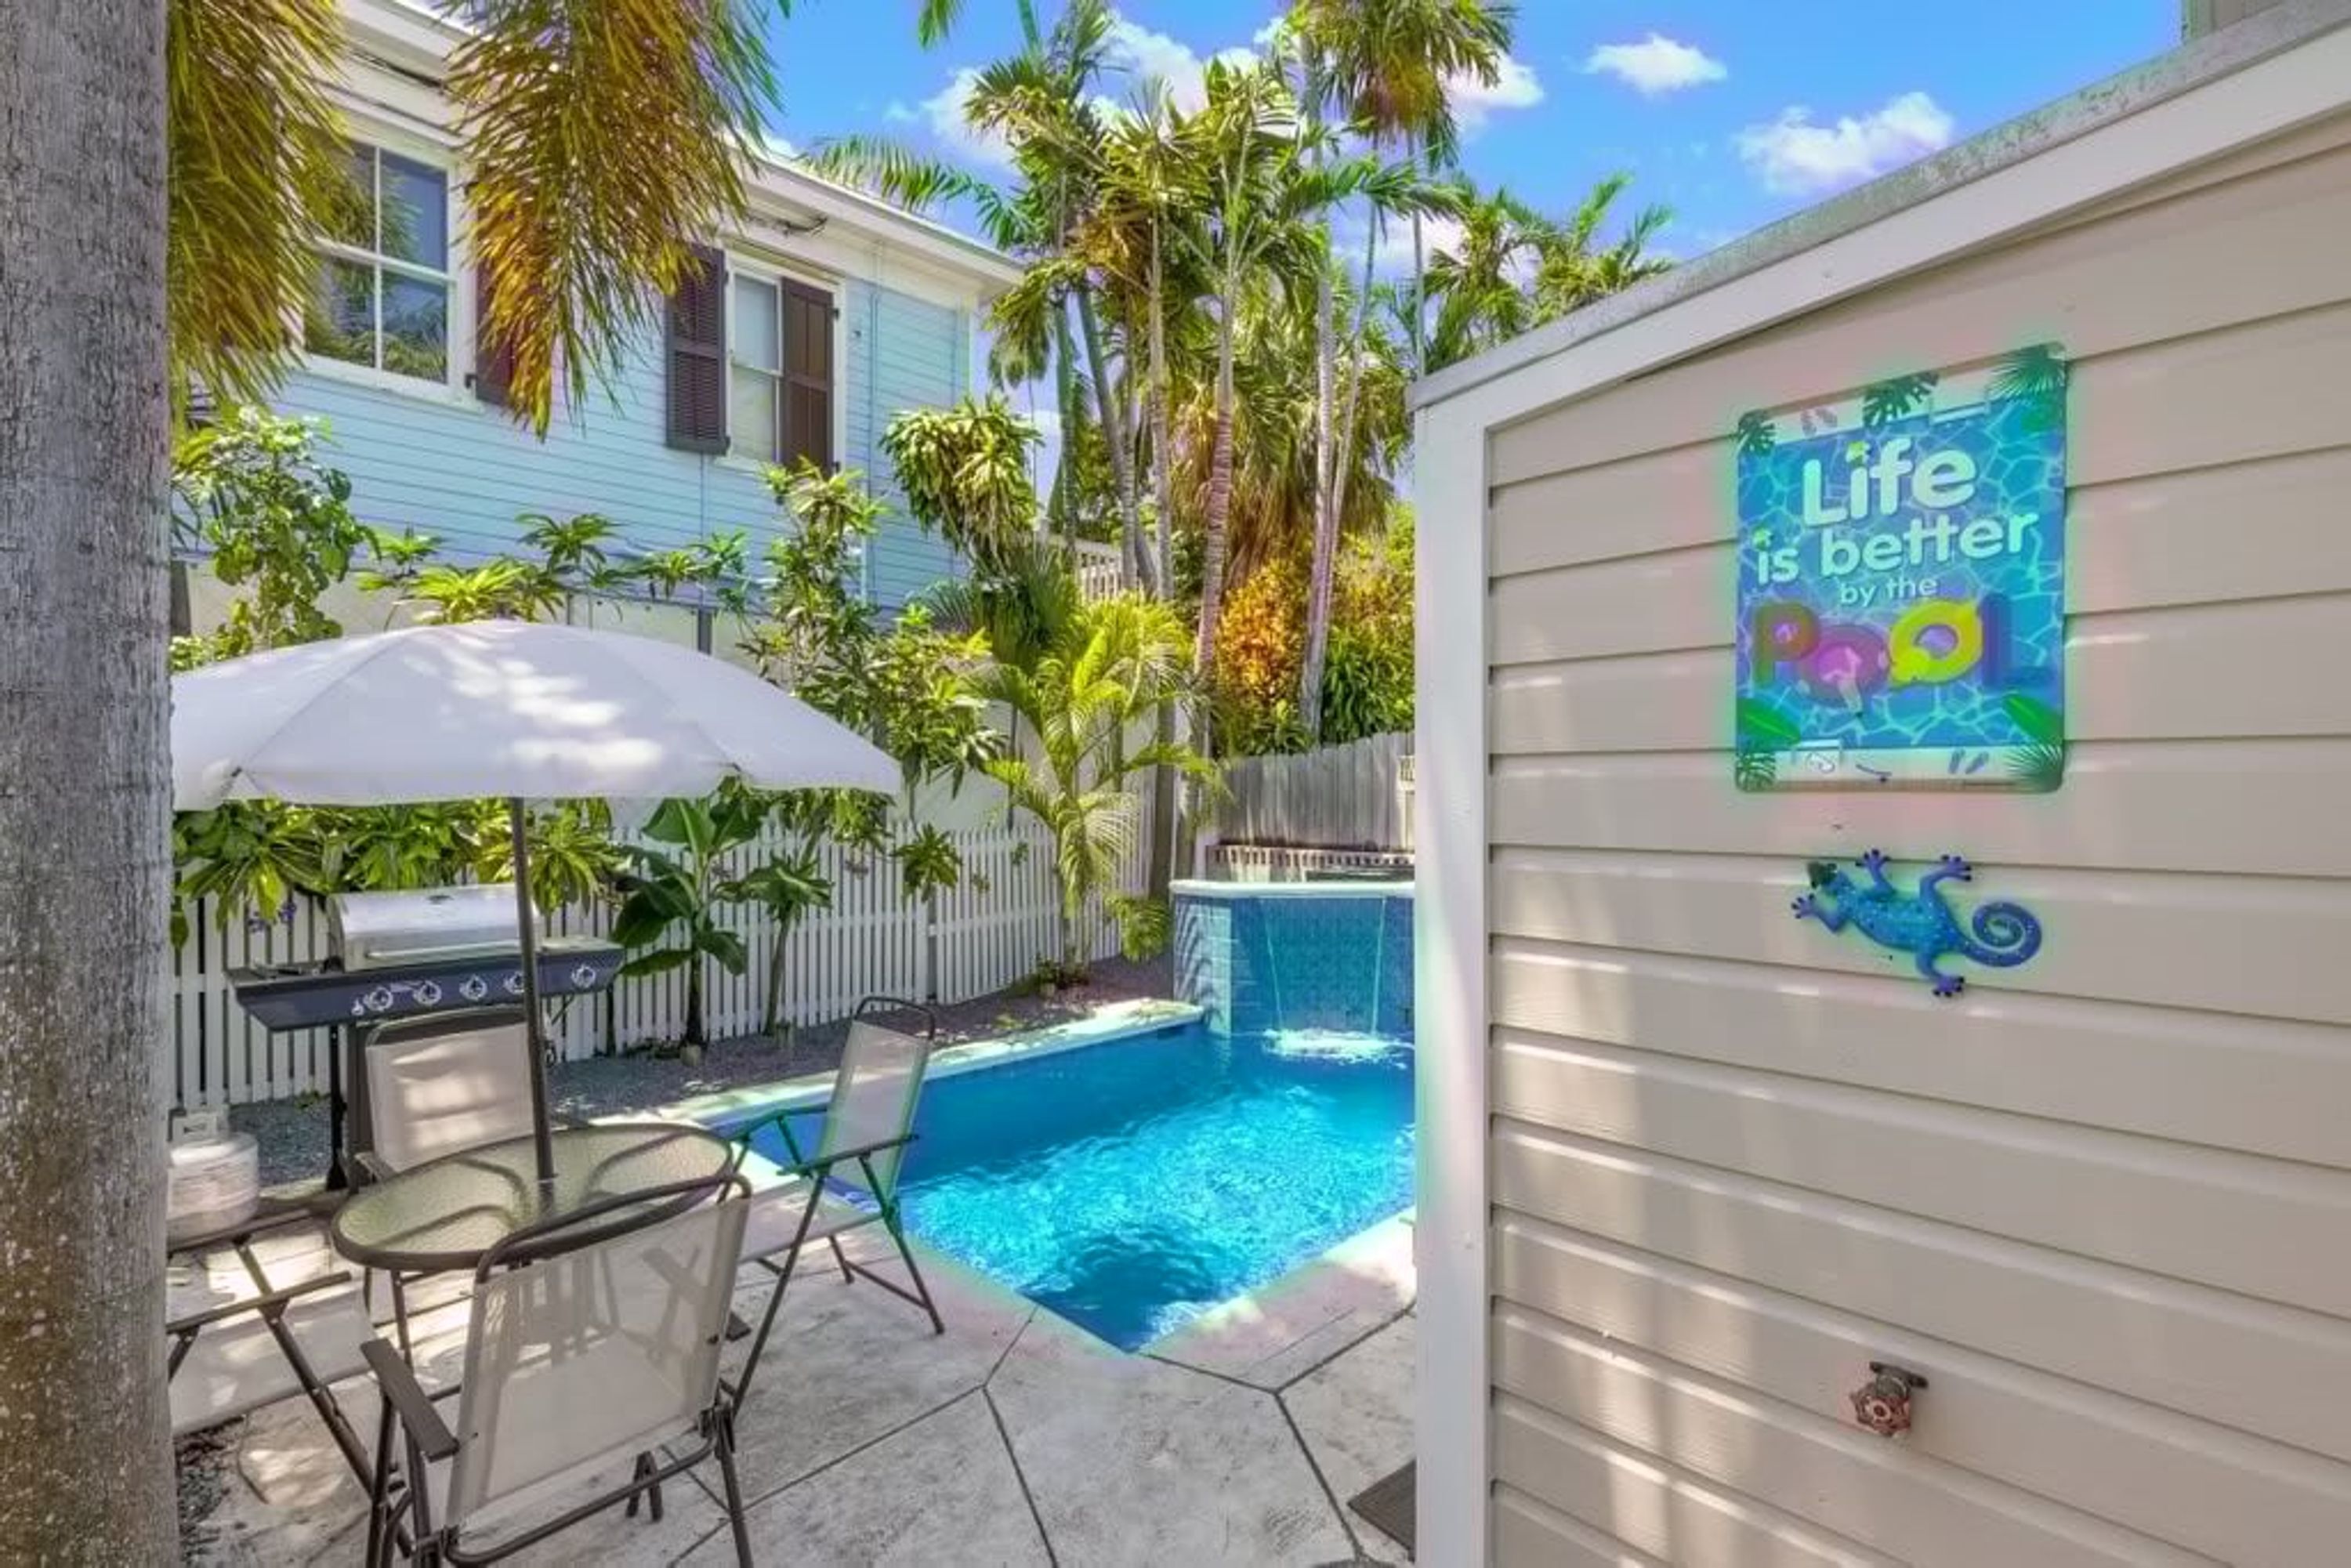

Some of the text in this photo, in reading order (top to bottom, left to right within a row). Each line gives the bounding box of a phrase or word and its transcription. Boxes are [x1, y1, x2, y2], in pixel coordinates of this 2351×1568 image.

[1803, 438, 1976, 526] Life
[1754, 512, 2039, 585] is better
[1840, 577, 1937, 607] by the
